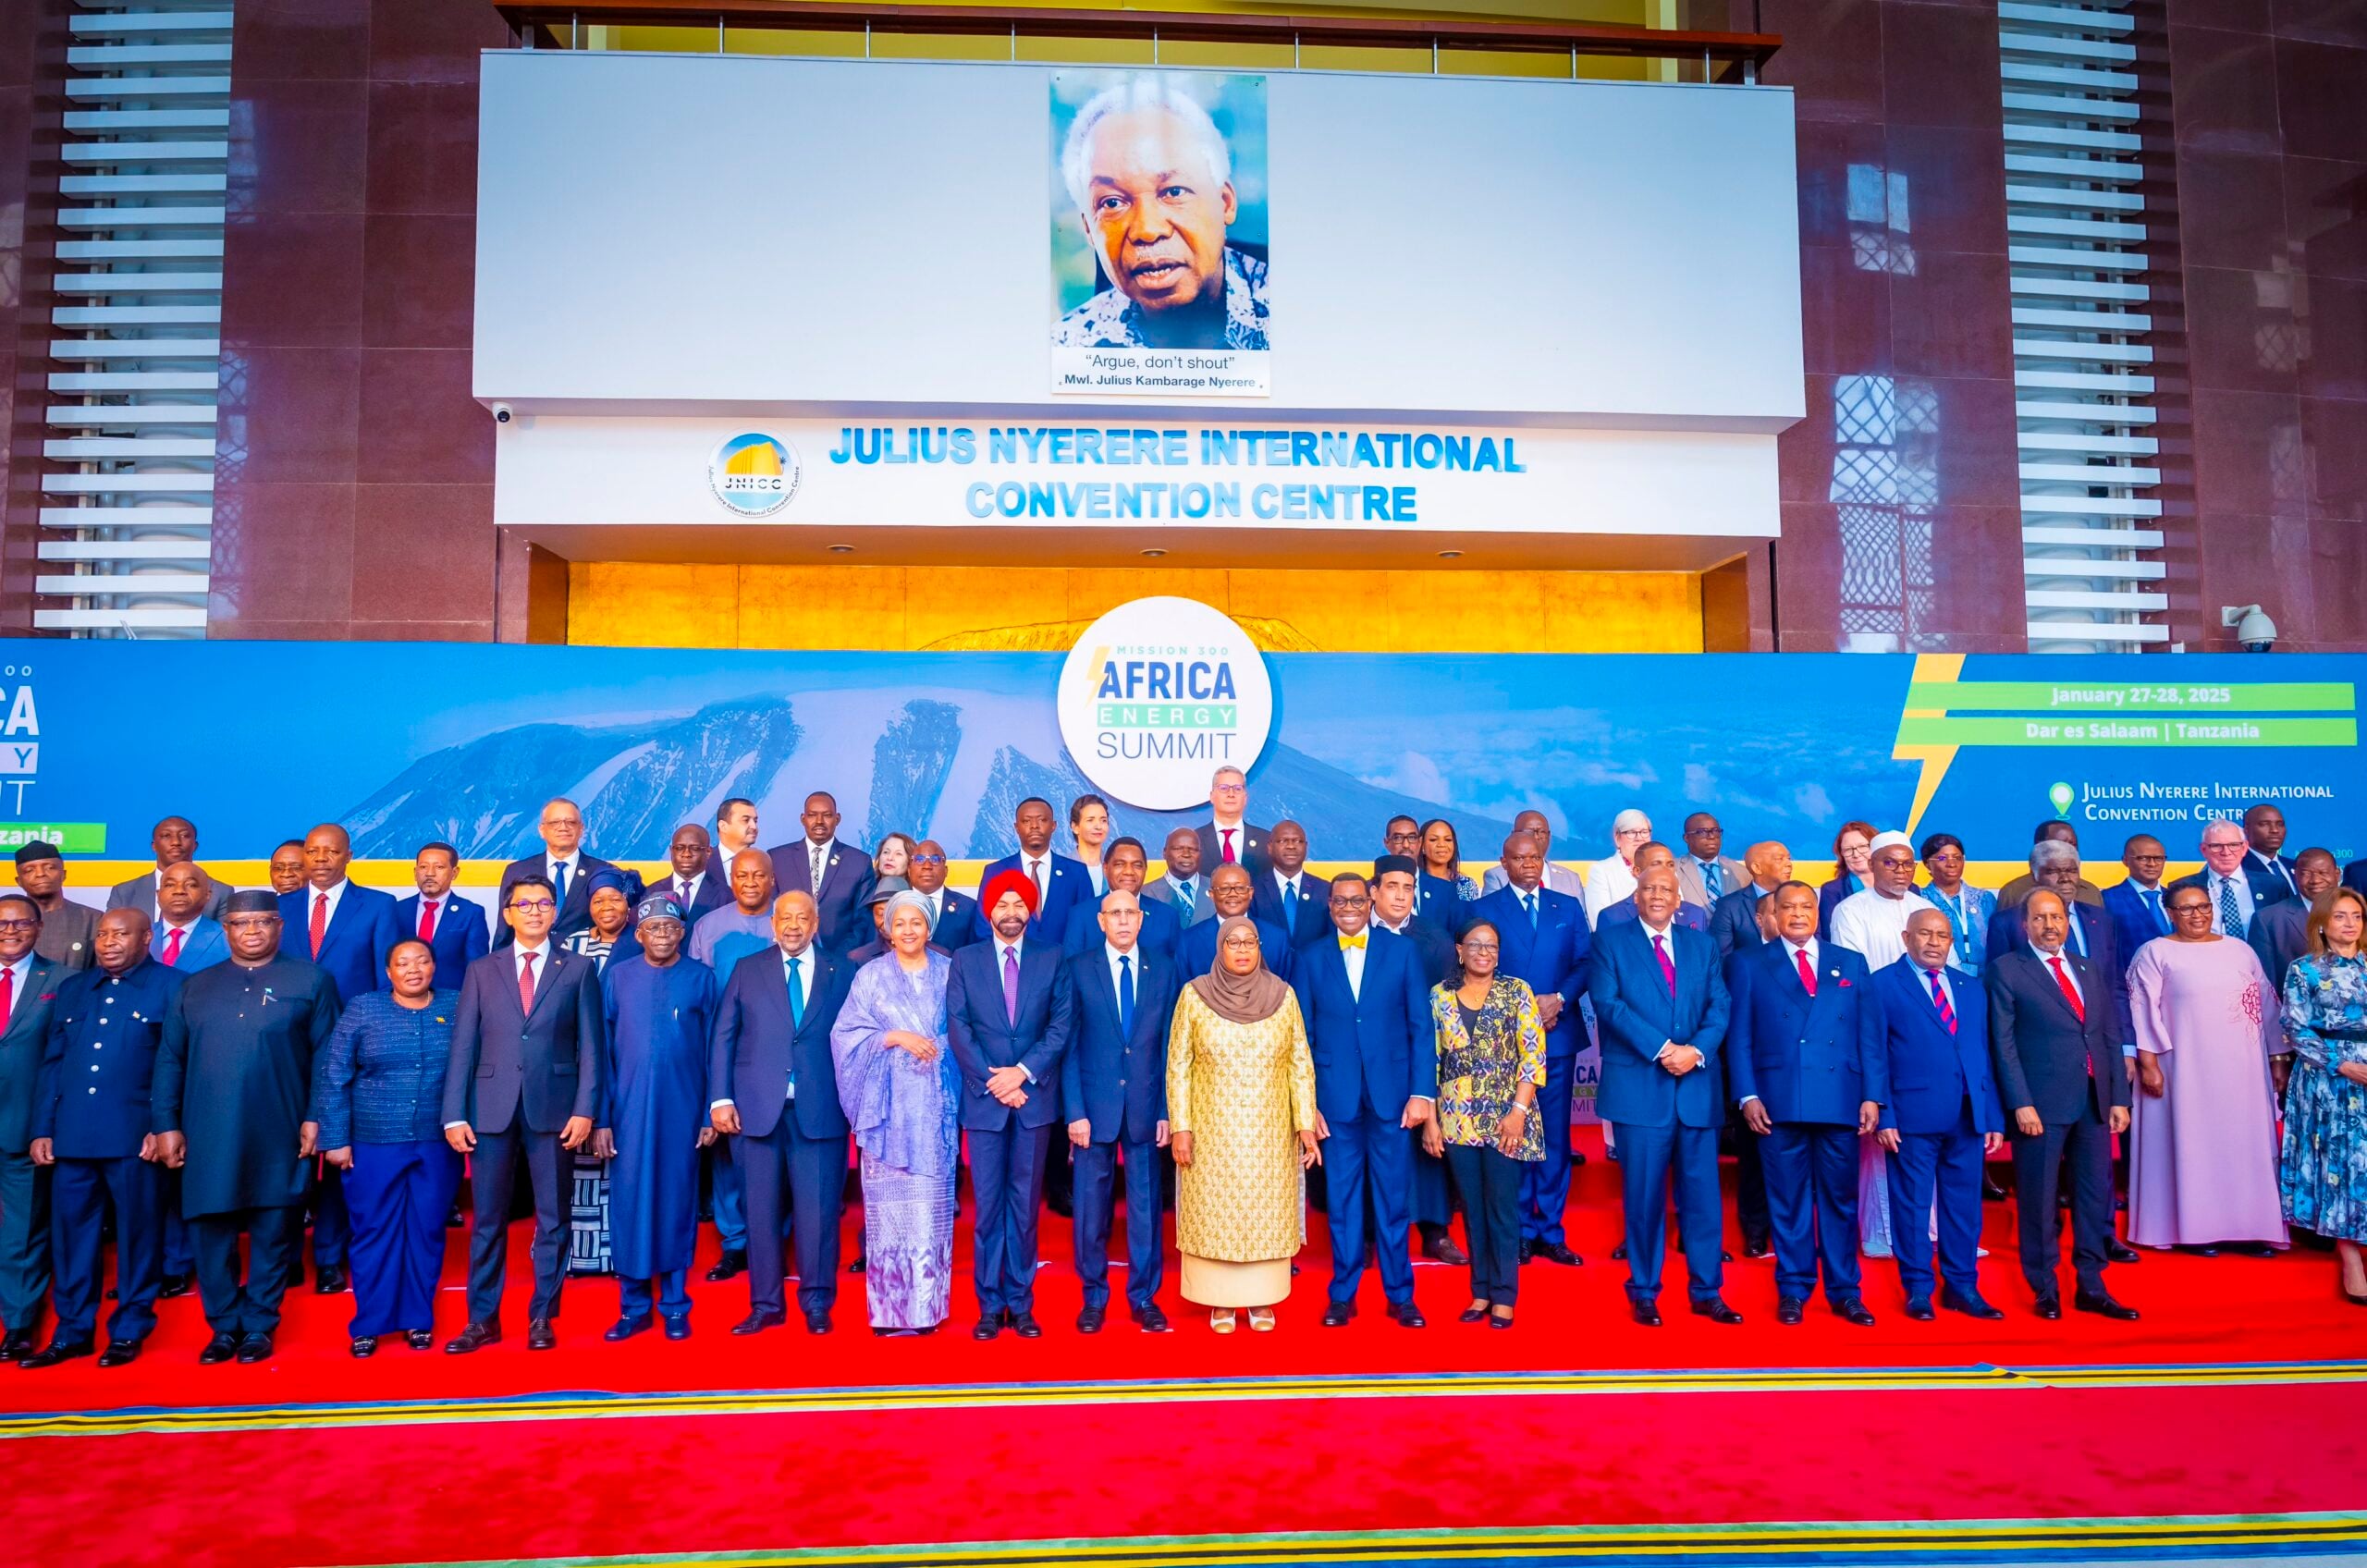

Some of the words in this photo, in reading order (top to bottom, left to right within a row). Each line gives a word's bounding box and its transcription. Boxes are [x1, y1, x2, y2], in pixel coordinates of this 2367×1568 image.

[1064, 374, 1093, 385] Mwl.
[1097, 375, 1132, 386] Julius
[1135, 375, 1205, 387] Kambarage
[1208, 376, 1256, 388] Nyerere
[829, 427, 976, 464] JULIUS
[989, 428, 1188, 465] NYERERE
[1201, 430, 1527, 473] INTERNATIONAL
[725, 477, 781, 490] JNICC
[726, 503, 767, 516] International
[767, 488, 796, 513] Convention
[791, 466, 800, 487] Centre
[966, 481, 1241, 519] CONVENTION
[1251, 484, 1417, 521] CENTRE
[1117, 646, 1188, 655] MISSION
[1198, 647, 1229, 655] 300
[1098, 661, 1236, 700] AFRICA
[2051, 687, 2125, 706] January
[2129, 688, 2184, 704] 27-28,
[2189, 688, 2230, 703] 2025
[1100, 708, 1233, 725] ENERGY
[2026, 723, 2059, 738] Dar
[2064, 726, 2085, 738] es
[2089, 723, 2158, 739] Salaam
[2175, 723, 2260, 739] Tanzania
[1097, 732, 1237, 759] SUMMIT
[2082, 782, 2133, 802] JULIUS
[2140, 782, 2209, 799] NYERERE
[2214, 782, 2334, 799] INTERNATIONAL
[2085, 803, 2188, 821] CONVENTION
[2193, 803, 2250, 821] CENTR
